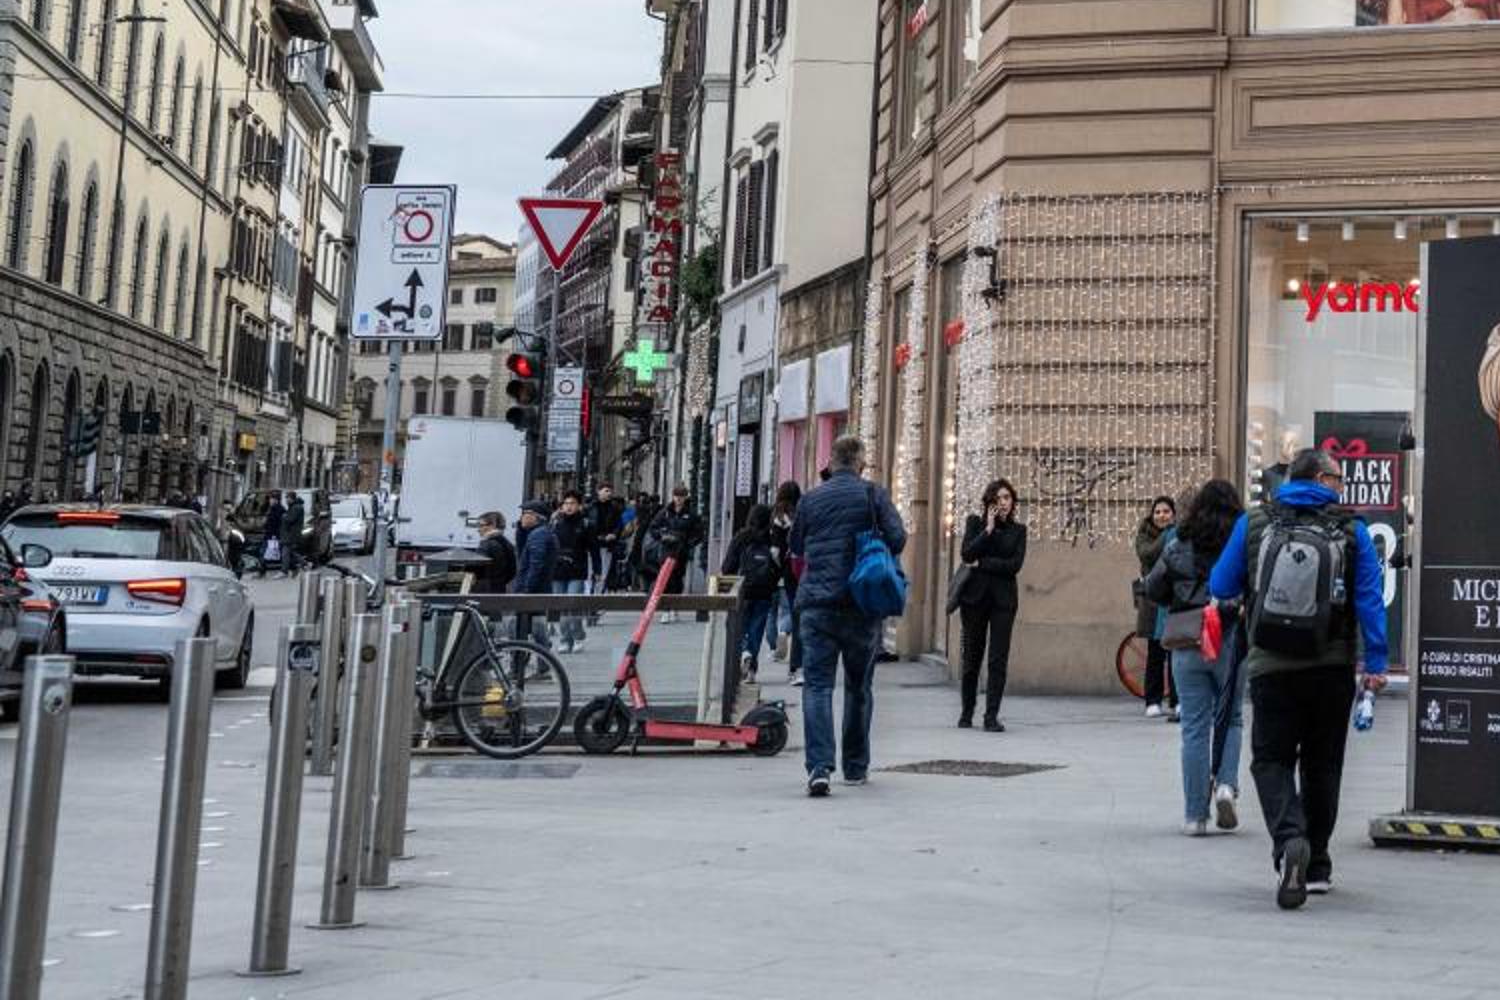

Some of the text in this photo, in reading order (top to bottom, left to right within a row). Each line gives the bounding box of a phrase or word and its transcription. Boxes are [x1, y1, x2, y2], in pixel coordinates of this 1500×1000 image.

[648, 153, 684, 323] FARMACIA
[1340, 460, 1392, 482] LACK
[1339, 483, 1392, 505] RIDAY
[1475, 605, 1490, 628] E
[1431, 652, 1450, 662] CURA
[1428, 665, 1457, 676] SERGIO
